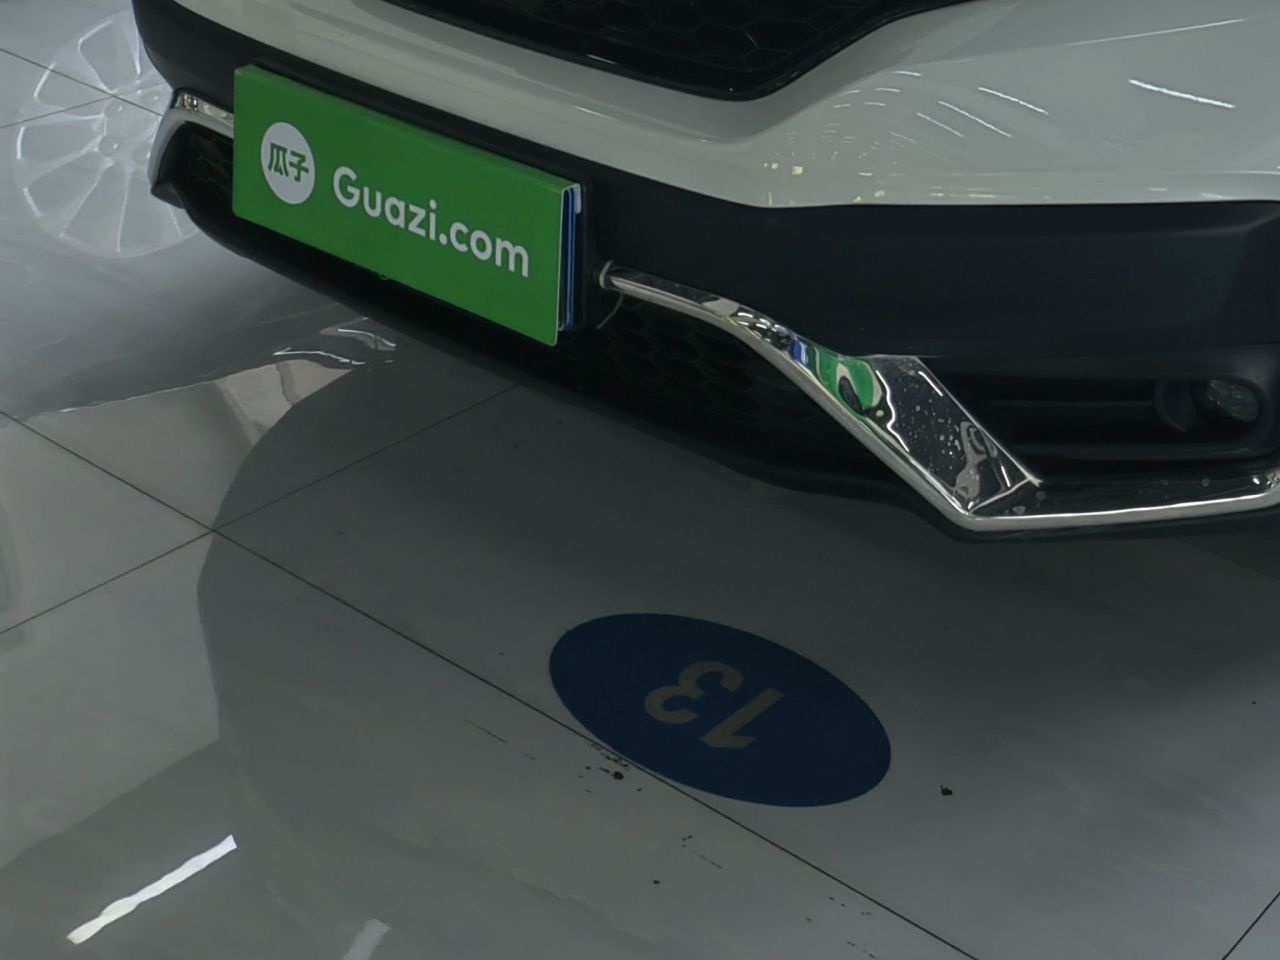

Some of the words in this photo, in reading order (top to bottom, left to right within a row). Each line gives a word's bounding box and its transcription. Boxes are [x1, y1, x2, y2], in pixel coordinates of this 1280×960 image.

[268, 142, 309, 182] 瓜子
[332, 166, 530, 278] Guazi.com
[644, 661, 784, 749] 13
